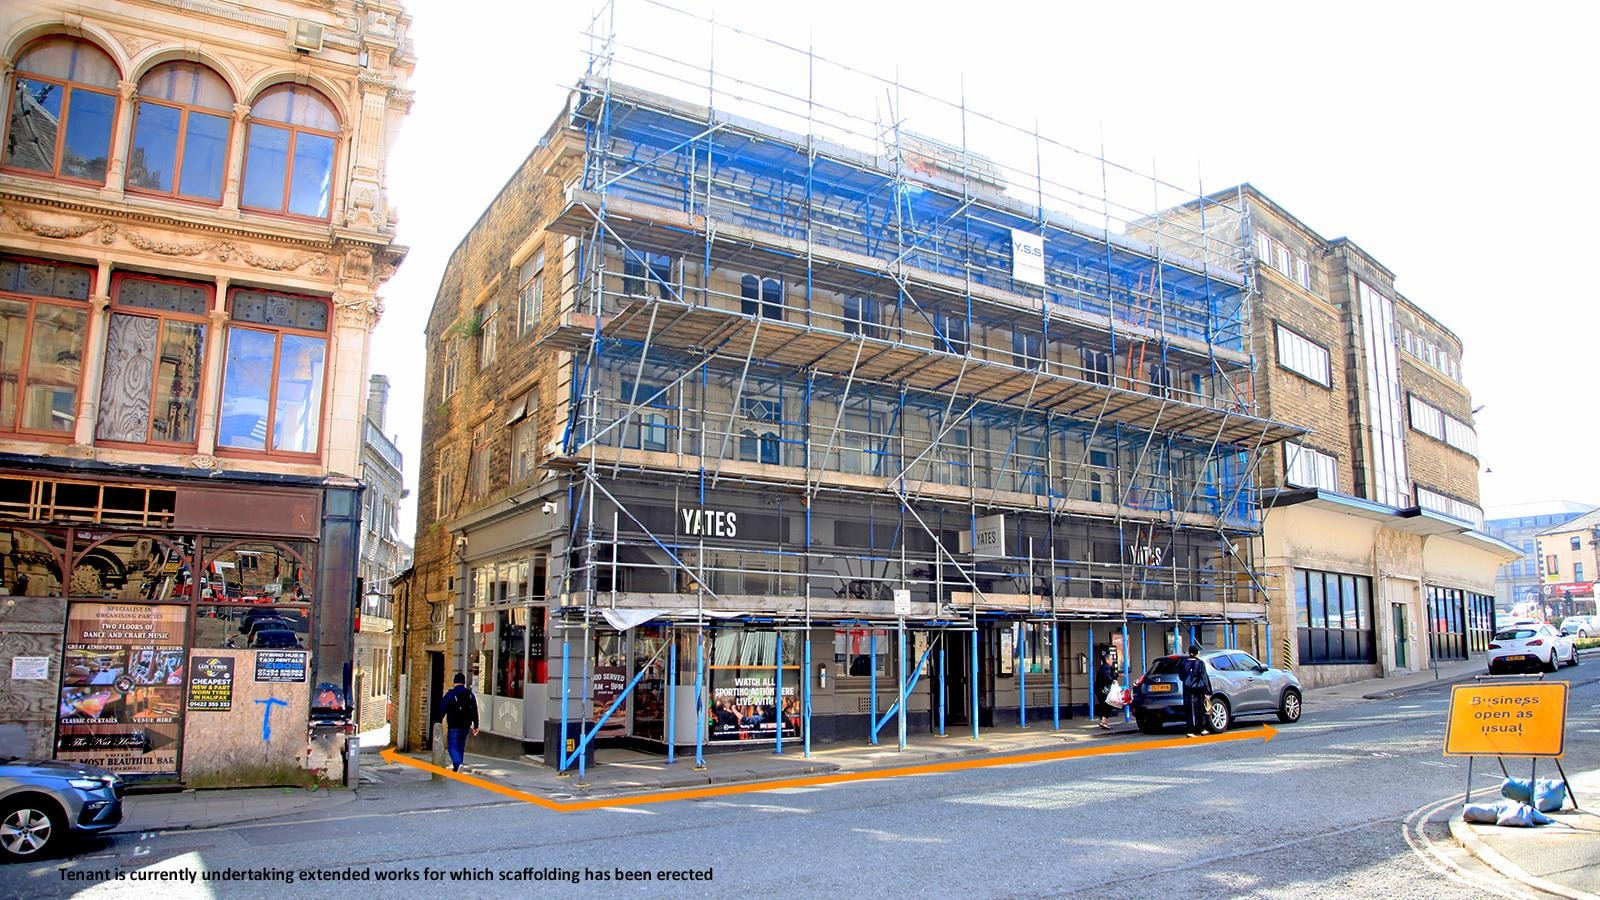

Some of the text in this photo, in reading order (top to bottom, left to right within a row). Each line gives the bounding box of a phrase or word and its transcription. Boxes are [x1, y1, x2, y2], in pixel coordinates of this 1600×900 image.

[1014, 241, 1042, 257] Y.S.S
[681, 508, 737, 537] YATES
[976, 530, 997, 546] YATES
[603, 673, 625, 682] SERVED
[735, 678, 776, 686] WATCH ALL
[715, 687, 794, 696] SPORTING ACTION ERE
[1474, 710, 1533, 720] open as
[1482, 723, 1523, 736] usual
[69, 737, 144, 747] The Nut House
[107, 758, 154, 766] BEAUTIFUL
[156, 757, 175, 765] BAR
